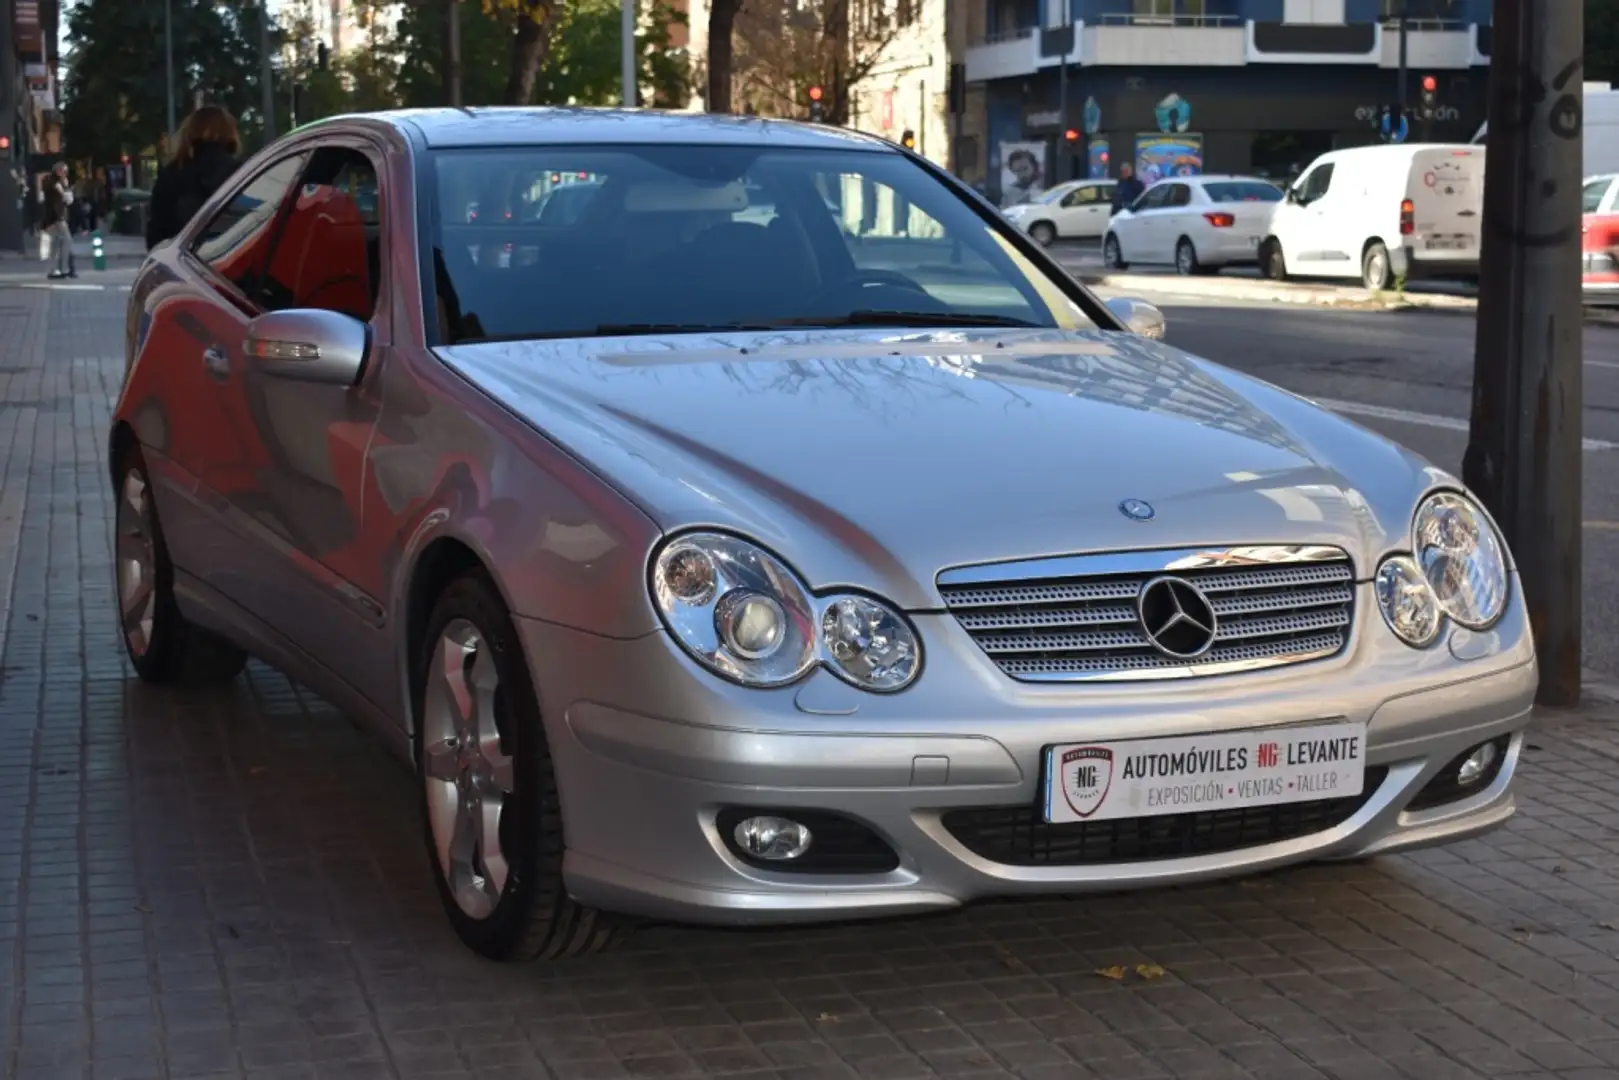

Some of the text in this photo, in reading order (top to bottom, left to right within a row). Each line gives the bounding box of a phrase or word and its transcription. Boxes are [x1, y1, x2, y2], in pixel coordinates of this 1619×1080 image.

[1122, 746, 1248, 779] AUTOMÓVILES
[1256, 742, 1278, 768] NG
[1287, 737, 1359, 765] LEVANTE
[1077, 765, 1097, 788] NG
[1147, 771, 1338, 806] EXPOSICIÓN VENTAS TALLER
